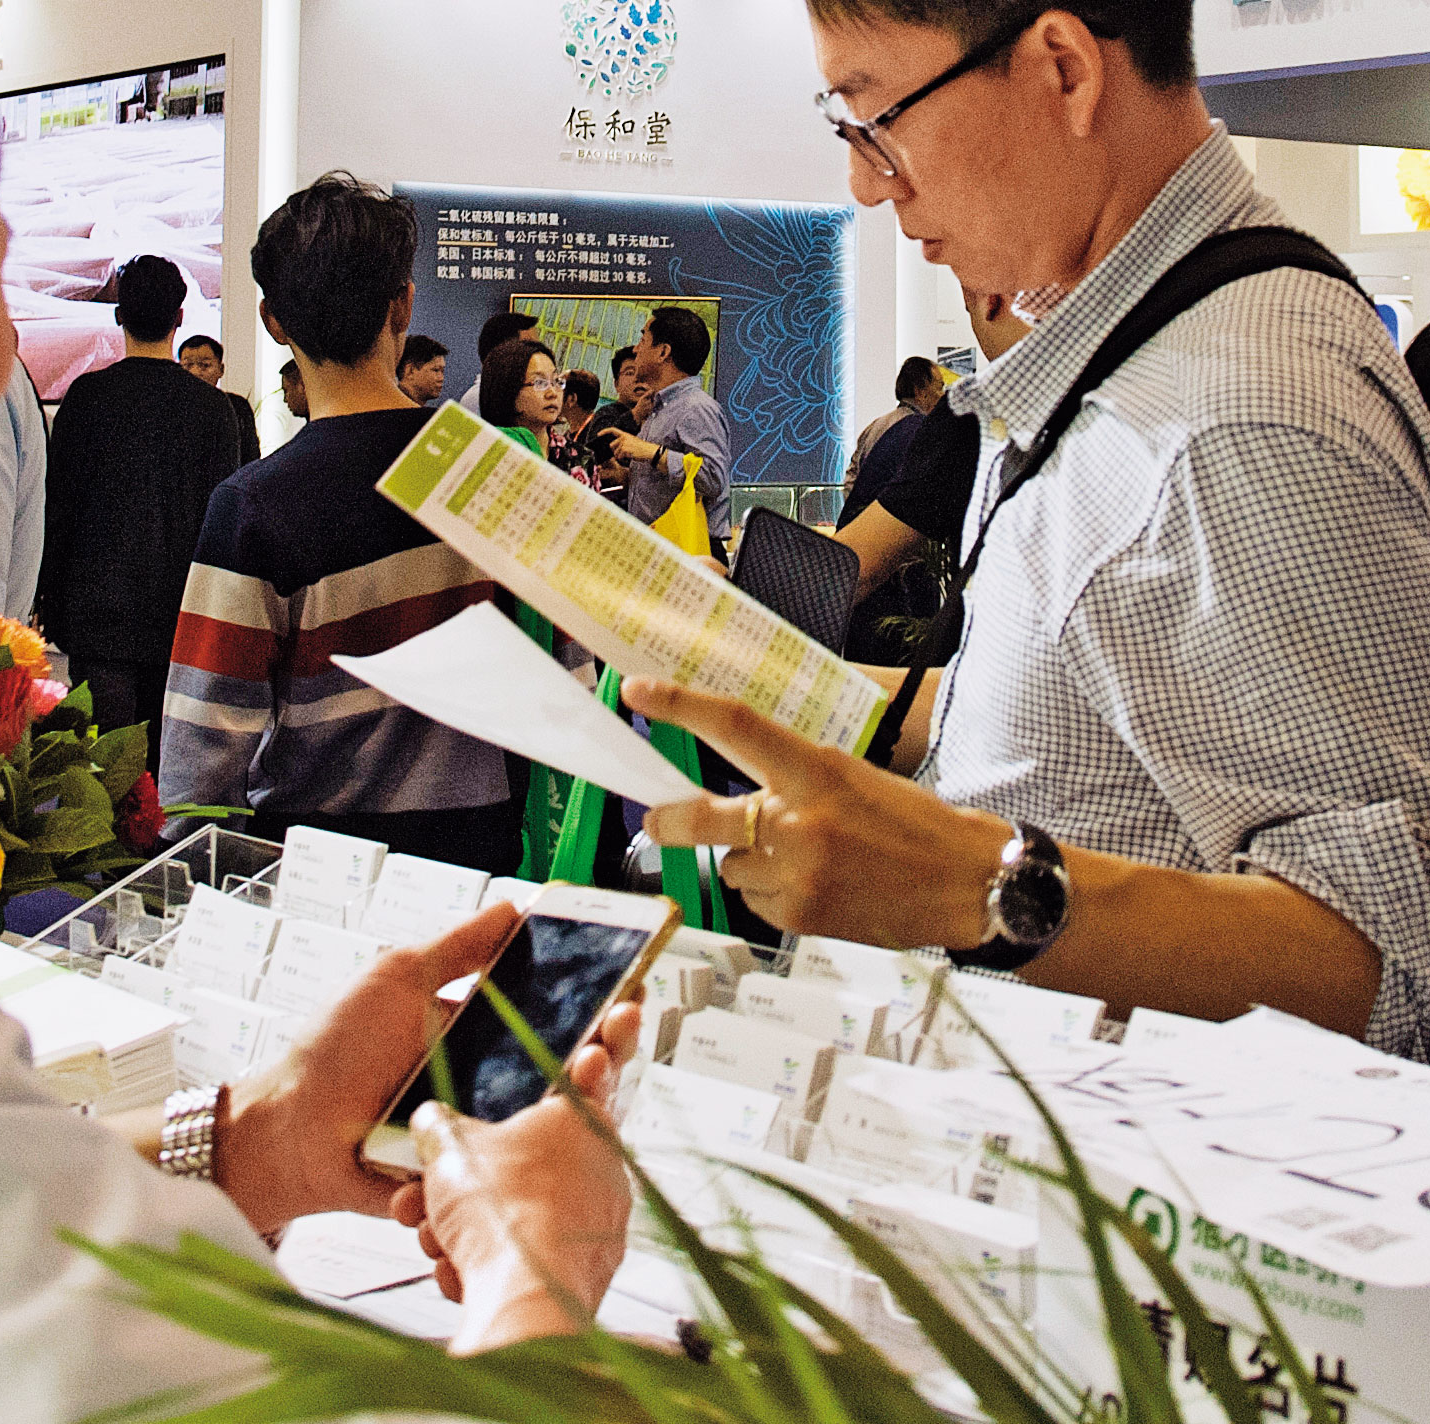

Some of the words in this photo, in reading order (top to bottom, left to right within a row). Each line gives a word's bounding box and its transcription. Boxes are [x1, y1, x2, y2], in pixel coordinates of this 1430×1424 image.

[564, 105, 671, 146] 保和堂
[578, 149, 602, 161] BAO
